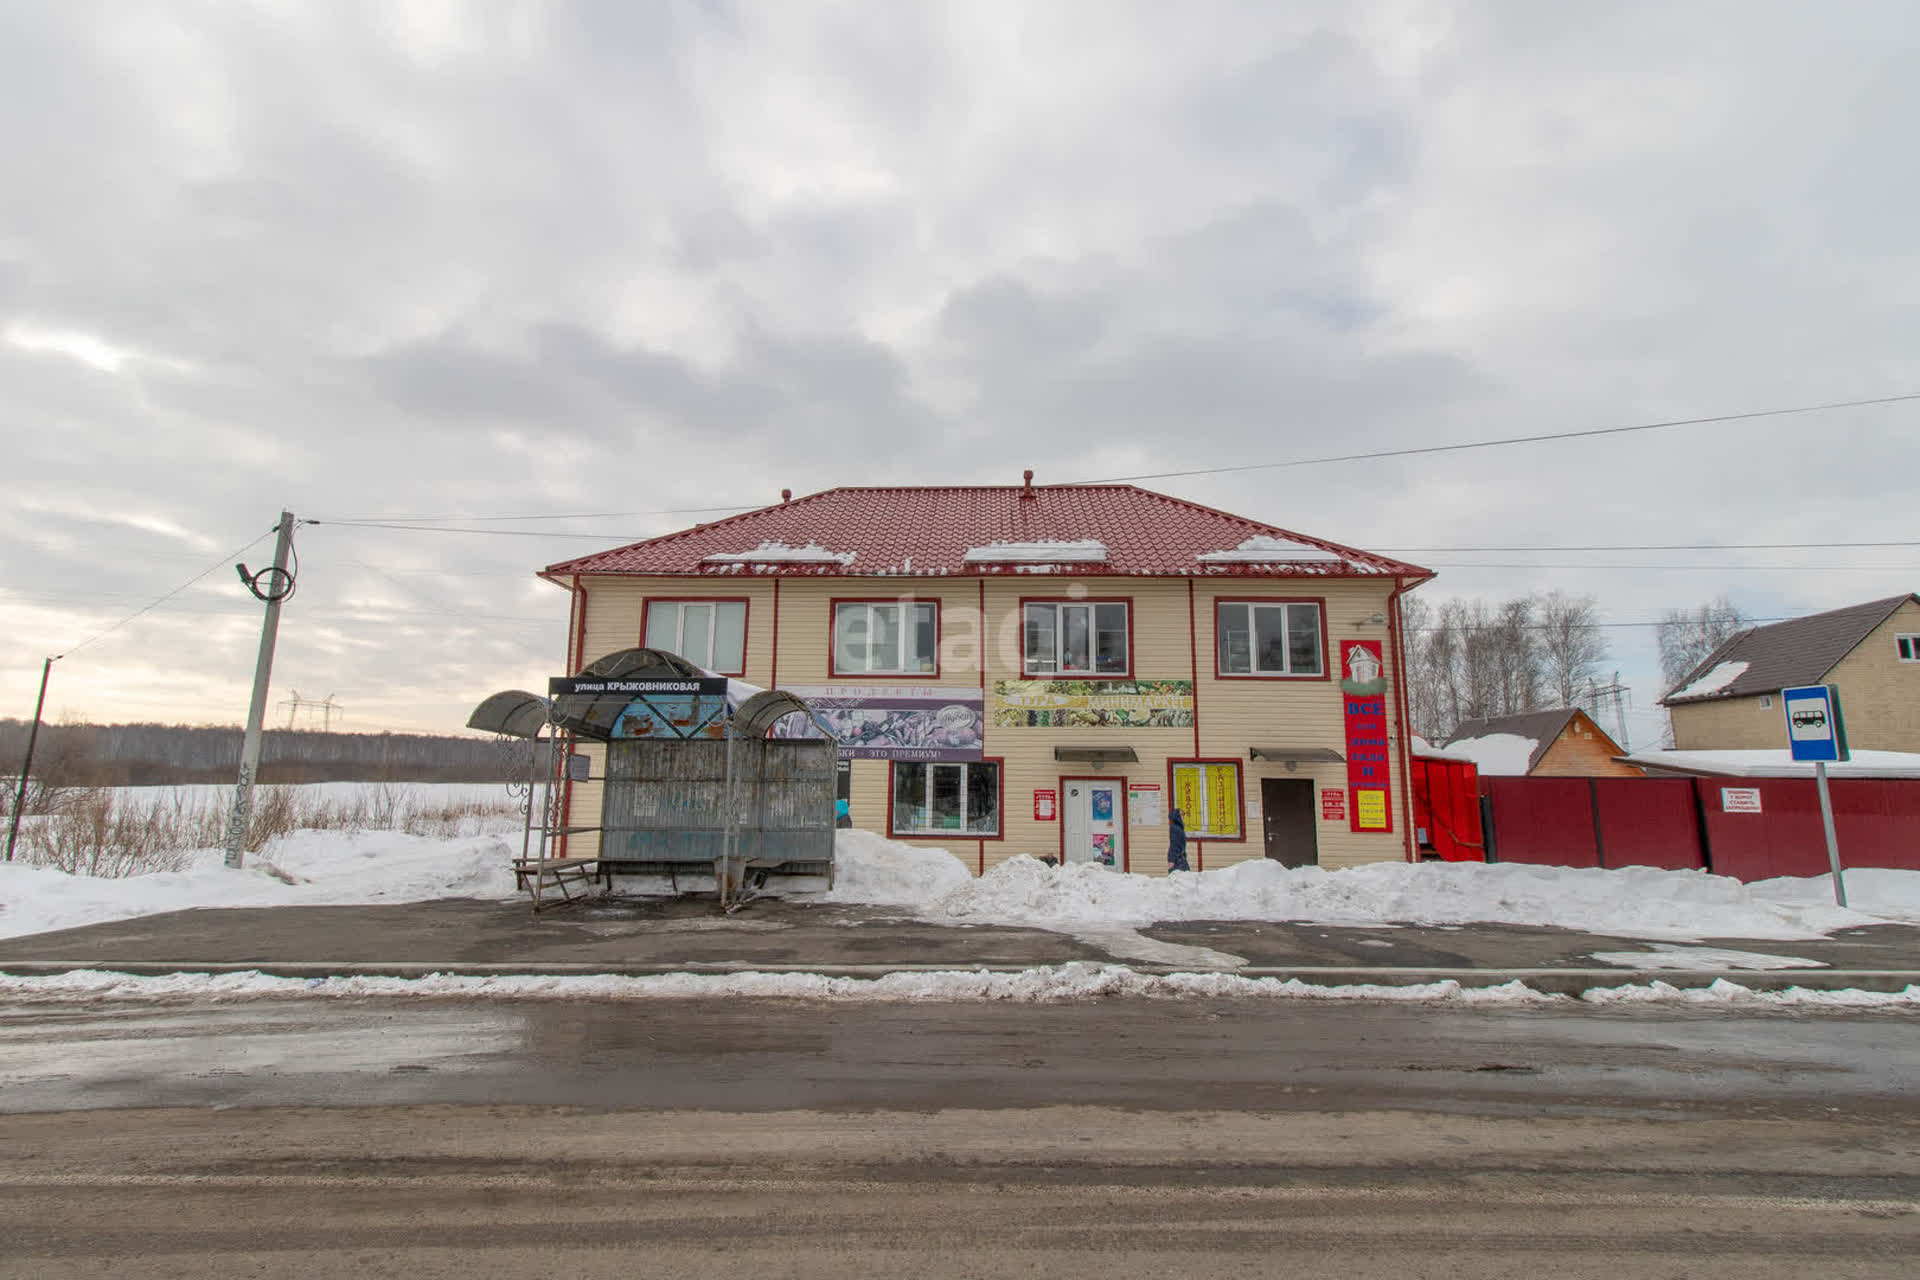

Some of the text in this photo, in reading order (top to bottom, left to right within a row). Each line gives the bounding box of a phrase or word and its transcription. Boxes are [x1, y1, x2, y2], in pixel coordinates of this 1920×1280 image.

[574, 682, 700, 692] улица КРЫЖОВНИКОВАЯ
[870, 750, 888, 758] ЭТО
